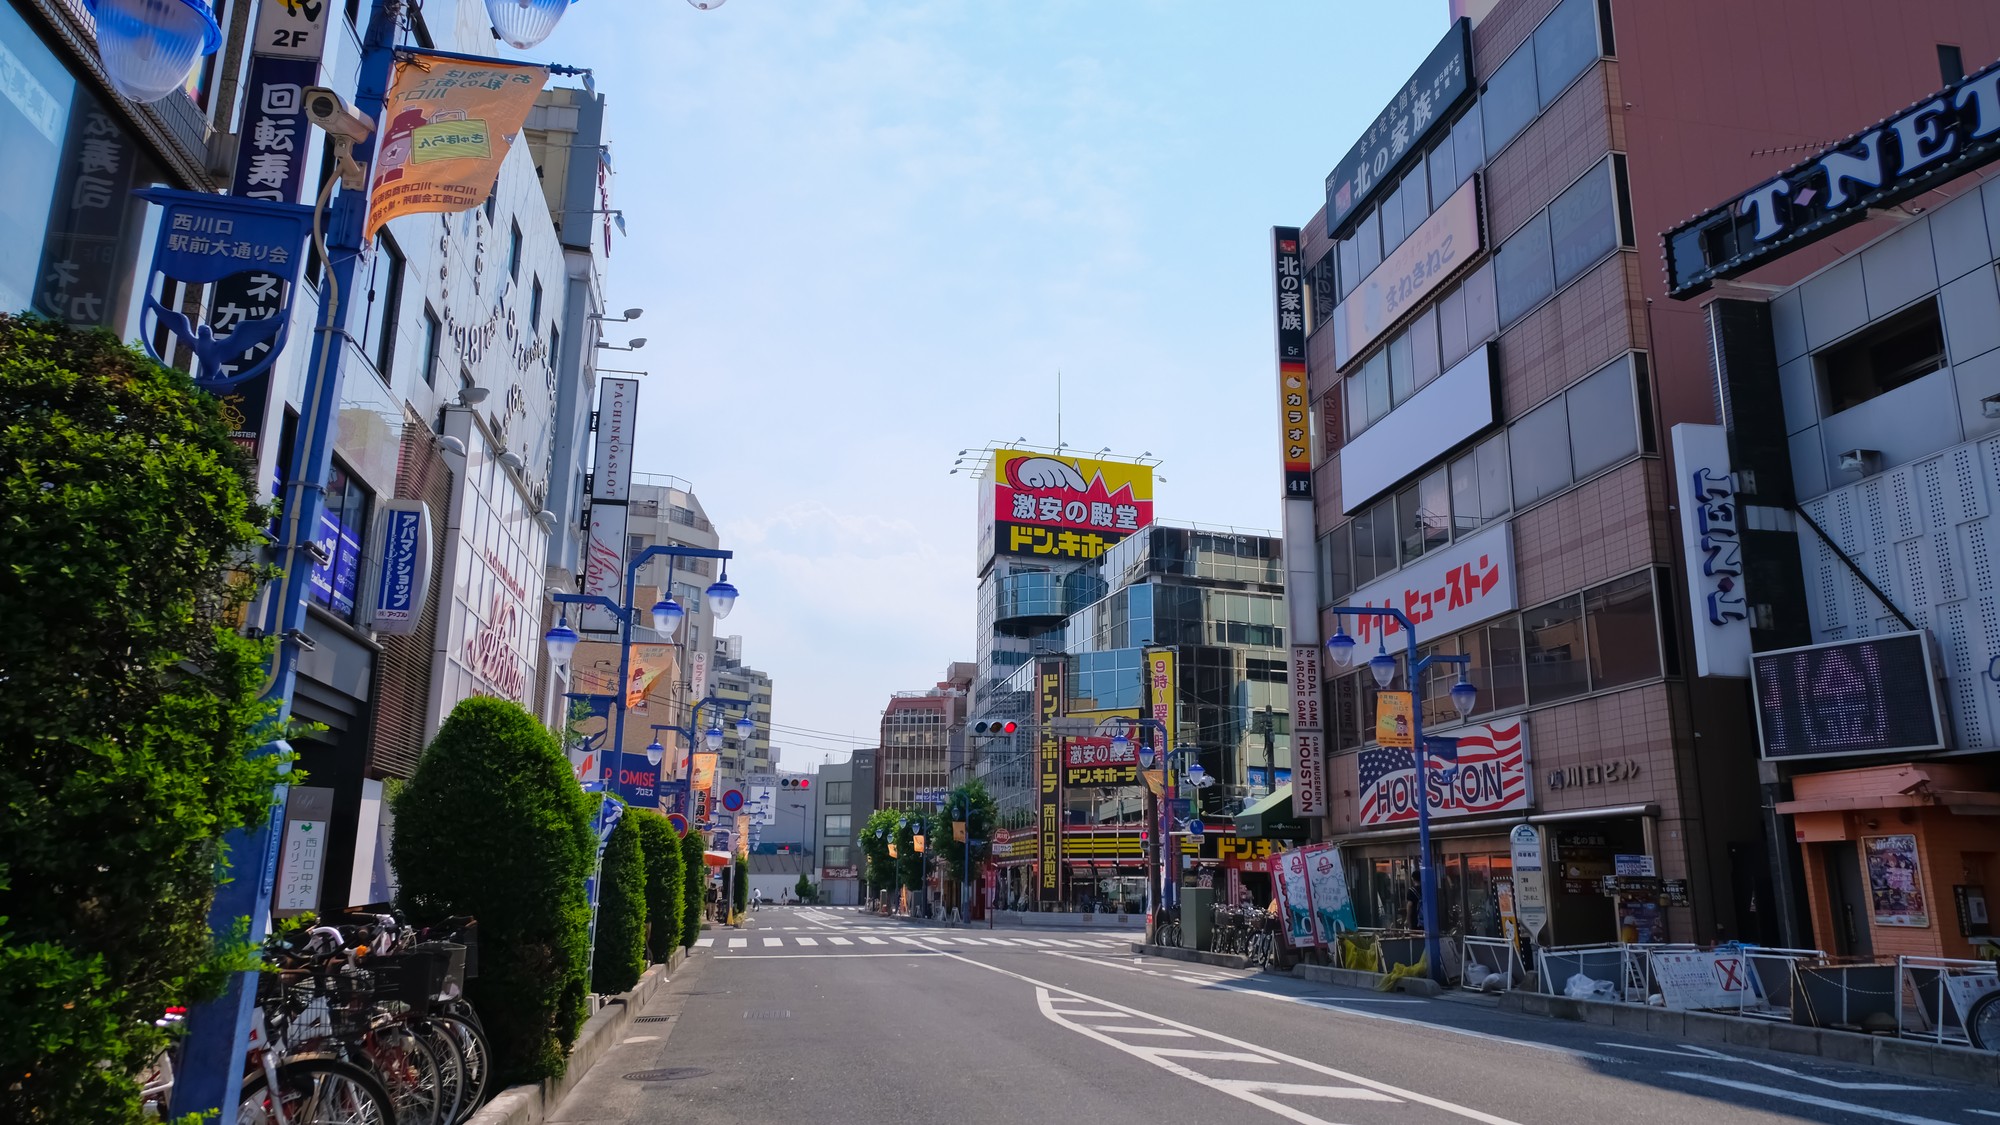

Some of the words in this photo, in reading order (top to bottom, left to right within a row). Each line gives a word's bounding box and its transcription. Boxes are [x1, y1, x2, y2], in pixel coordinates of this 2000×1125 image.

[271, 29, 309, 48] 2F
[1353, 89, 1432, 200] 北の家族
[172, 213, 234, 236] 西川口
[167, 233, 289, 264] 駅前大通り会
[1385, 234, 1456, 314] まねきねこ
[1278, 256, 1302, 331] 北の家族
[1287, 346, 1299, 356] 5F
[1286, 393, 1304, 458] カラオケ
[1288, 480, 1309, 491] 4F
[1011, 492, 1139, 530] 激安の殿堂
[393, 515, 418, 608] アパマンショップ
[1357, 553, 1500, 644] ゲームヒューストン
[1296, 649, 1303, 657] 1F
[1306, 650, 1315, 658] 2F
[1296, 660, 1306, 697] ARCADE
[1307, 659, 1317, 697] MEDAL
[1297, 700, 1307, 727] GAME
[1309, 700, 1318, 727] GAME
[1070, 743, 1136, 764] 激安の殿堂
[1312, 736, 1320, 757] GAME
[604, 767, 656, 788] POMISE
[1299, 736, 1313, 812] HOUSTON
[1313, 760, 1322, 806] AMUSEMENT
[1375, 761, 1504, 815] HOUSTON
[1549, 759, 1640, 790] 西川口ビル
[635, 787, 654, 797] プロミス
[1043, 803, 1057, 889] 西川口駅前店
[287, 840, 301, 895] クリニック
[299, 837, 318, 895] 西川口中央
[289, 897, 305, 908] 5F
